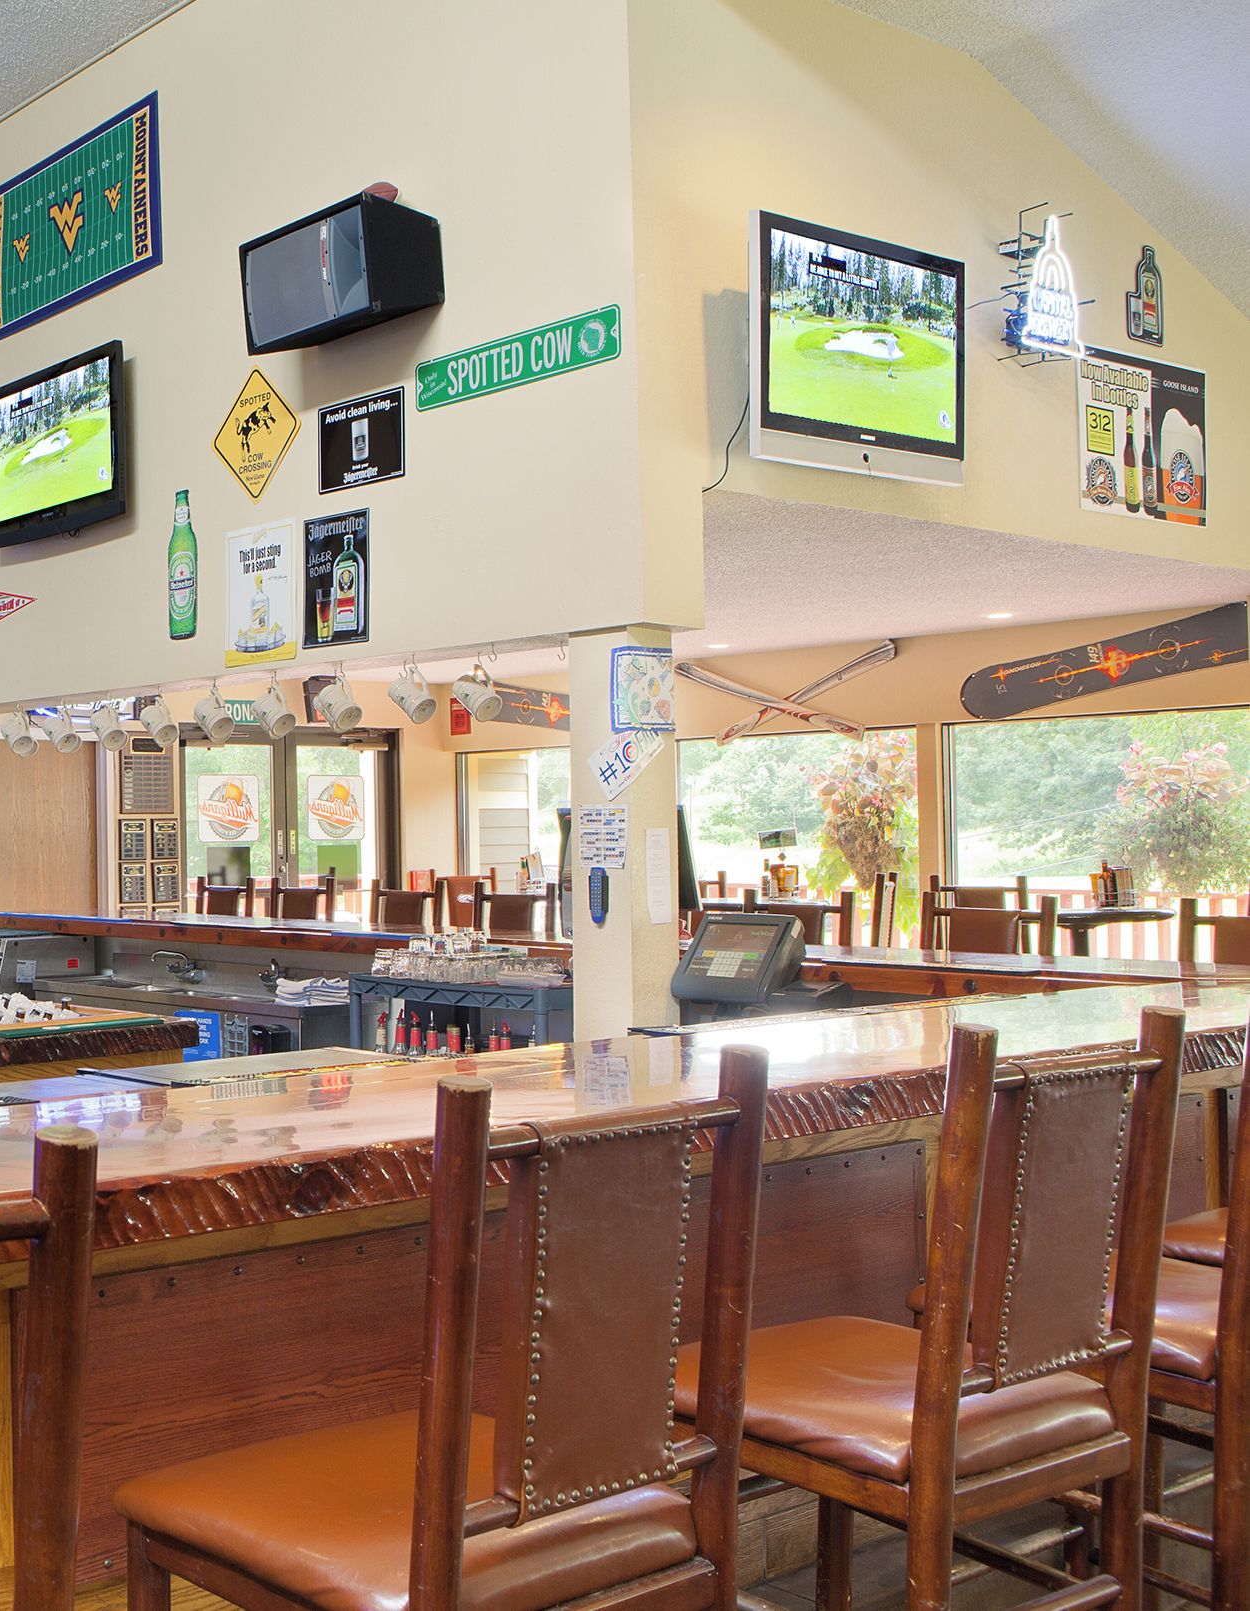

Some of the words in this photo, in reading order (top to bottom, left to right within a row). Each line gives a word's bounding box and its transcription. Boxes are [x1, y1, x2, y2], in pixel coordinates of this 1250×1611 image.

[134, 111, 150, 257] MOUNTAINEERS
[447, 342, 524, 396] SPOTTED
[530, 326, 573, 372] COW
[1081, 359, 1103, 382] Now
[1103, 364, 1150, 393] Available
[1092, 381, 1103, 402] In
[1103, 384, 1139, 410] Bottles
[1162, 380, 1180, 391] GOOSE
[1180, 384, 1199, 394] ISLAND
[239, 392, 271, 408] SPOTTED
[325, 410, 347, 424] Avoid
[347, 405, 368, 419] clean
[368, 399, 399, 413] living...
[1089, 411, 1112, 433] 312
[247, 452, 264, 463] COW
[238, 460, 272, 475] CROSSING
[255, 545, 266, 560] just
[266, 543, 281, 559] sting
[256, 555, 277, 572] second.
[310, 562, 332, 578] BOMB
[225, 703, 254, 721] RON
